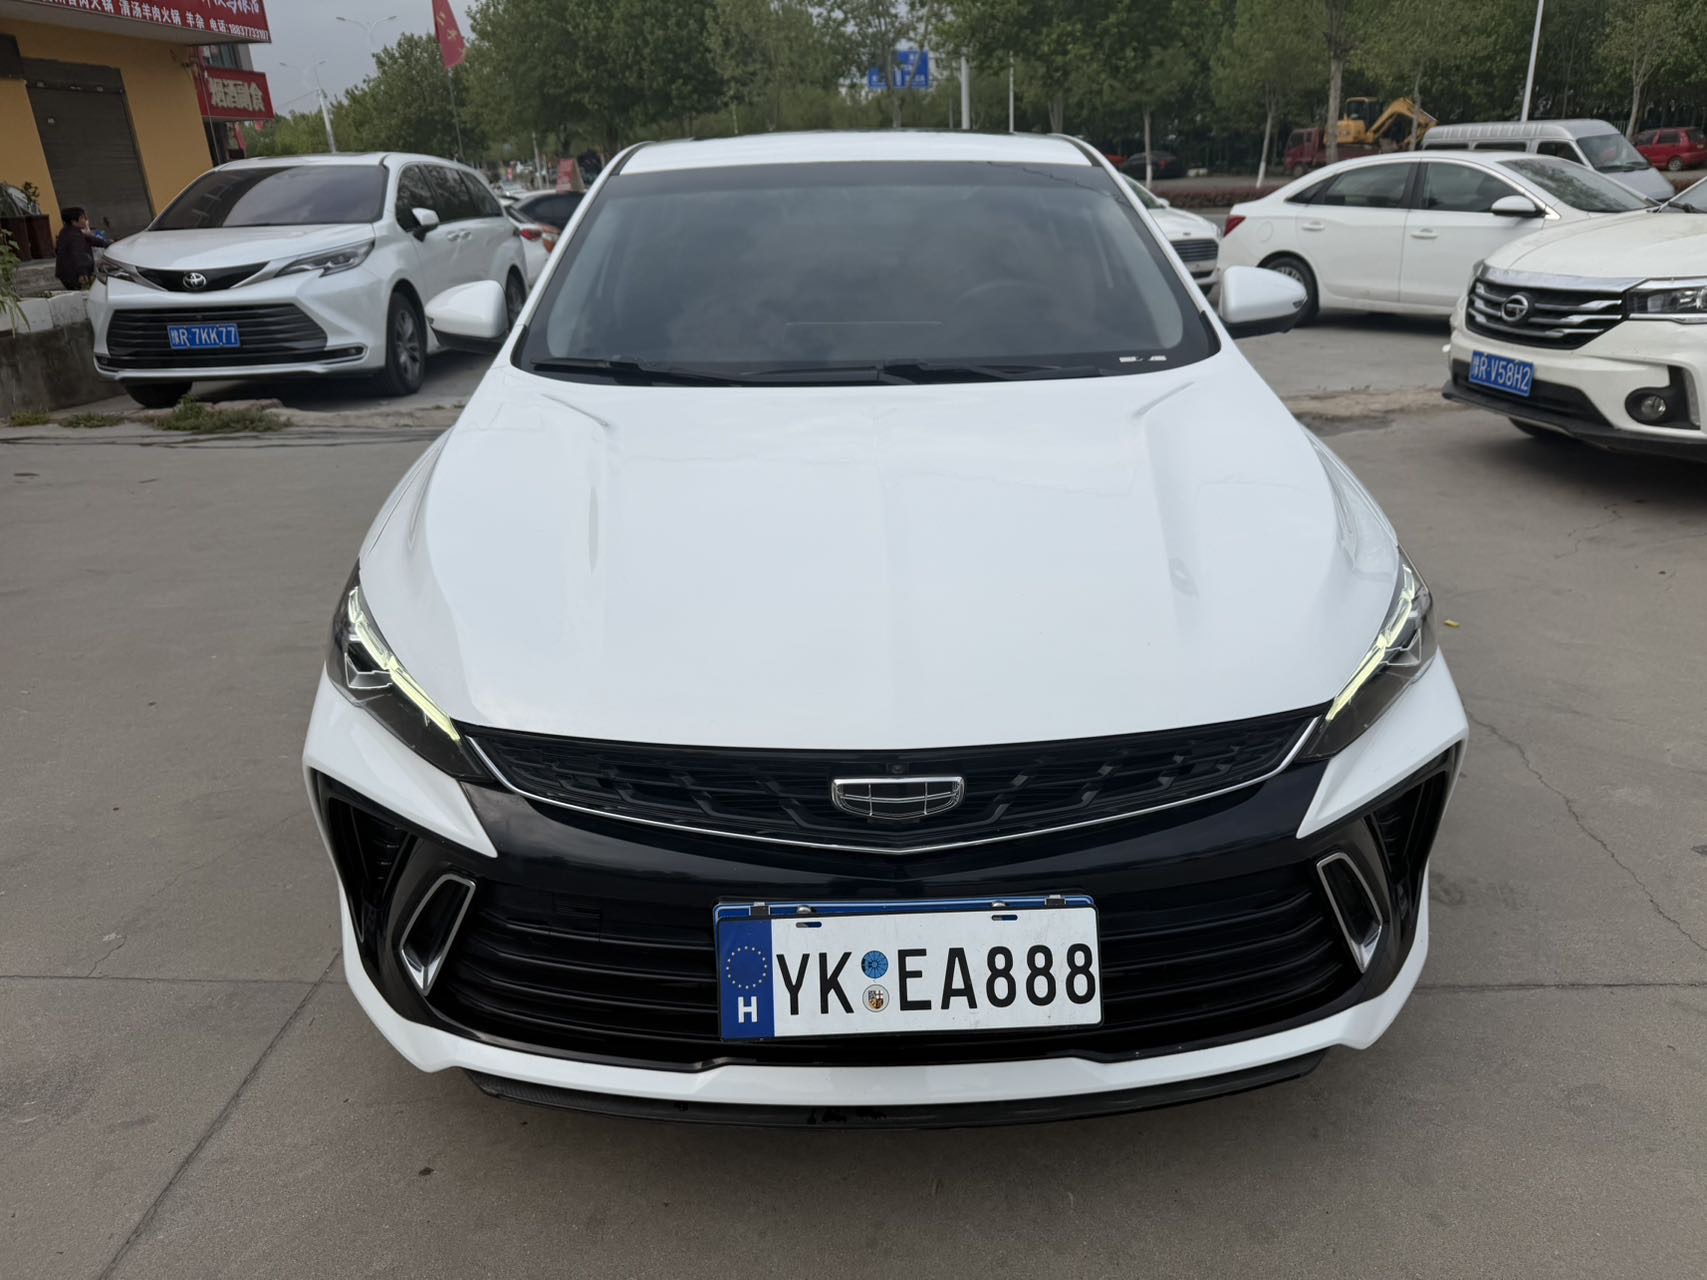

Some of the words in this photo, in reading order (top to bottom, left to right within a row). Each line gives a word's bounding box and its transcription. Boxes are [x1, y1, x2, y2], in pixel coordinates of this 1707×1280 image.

[119, 1, 182, 25] 清汤羊肉火锅
[185, 10, 205, 29] 羊杂
[208, 77, 266, 112] 烟酒副食
[776, 952, 854, 1015] YK
[898, 943, 1096, 1011] EA888
[738, 996, 758, 1023] H
